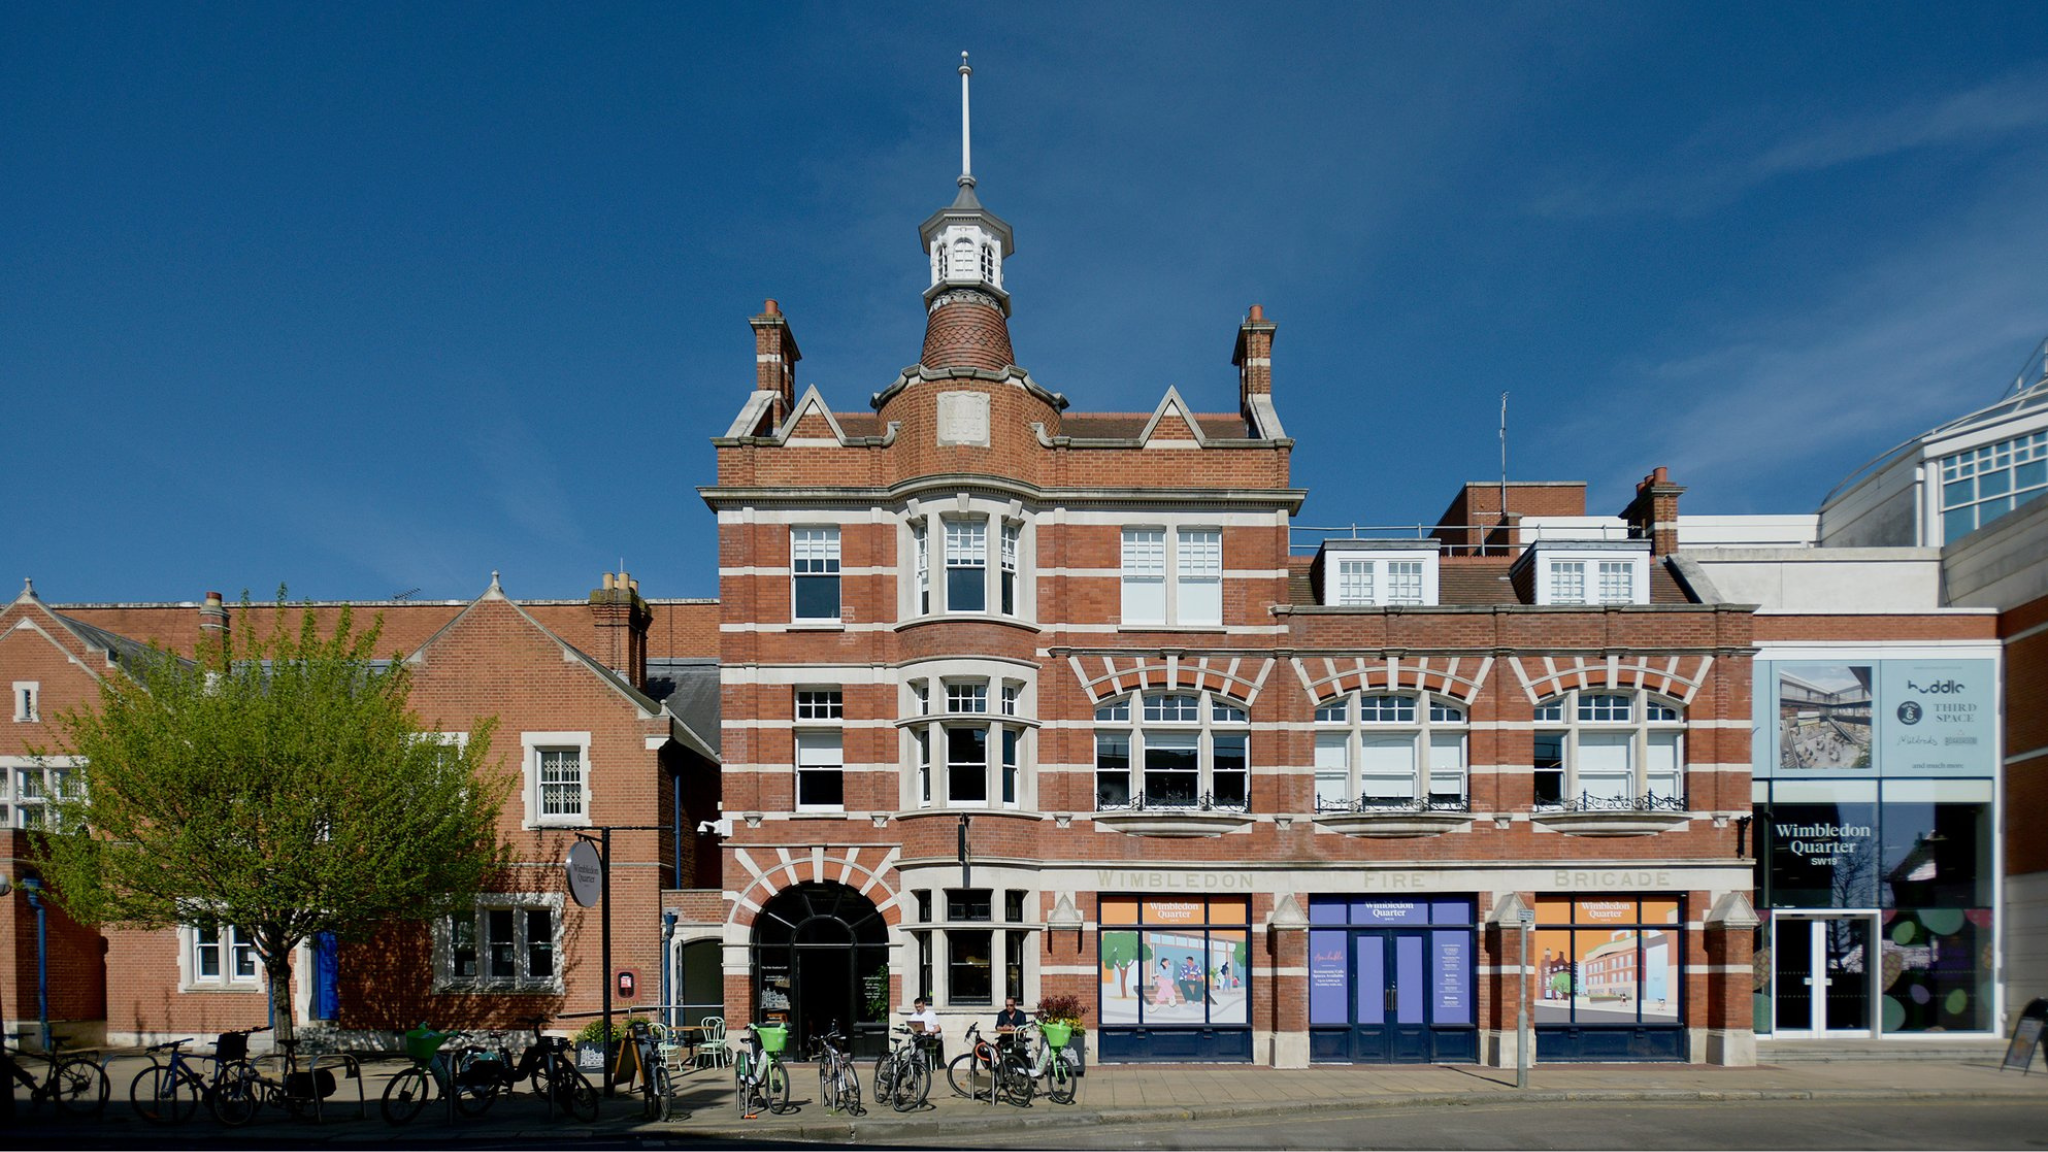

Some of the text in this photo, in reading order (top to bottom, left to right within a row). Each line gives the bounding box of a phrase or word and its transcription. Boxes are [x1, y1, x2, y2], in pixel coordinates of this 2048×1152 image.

[1933, 703, 1977, 712] THIRD
[1936, 714, 1974, 722] SPACE
[1775, 823, 1871, 837] Wimbledon
[1790, 840, 1856, 856] Quarter
[1811, 857, 1838, 865] SW19
[1097, 870, 1670, 888] WIMBLEDON FIRE BRIGADE
[1150, 902, 1198, 910] Wimbledon
[1365, 901, 1414, 909] Wimbledon
[1581, 902, 1630, 910] Wimbledon
[1157, 910, 1191, 919] Quarter
[1372, 909, 1406, 918] Quarter
[1589, 910, 1622, 919] Quarter
